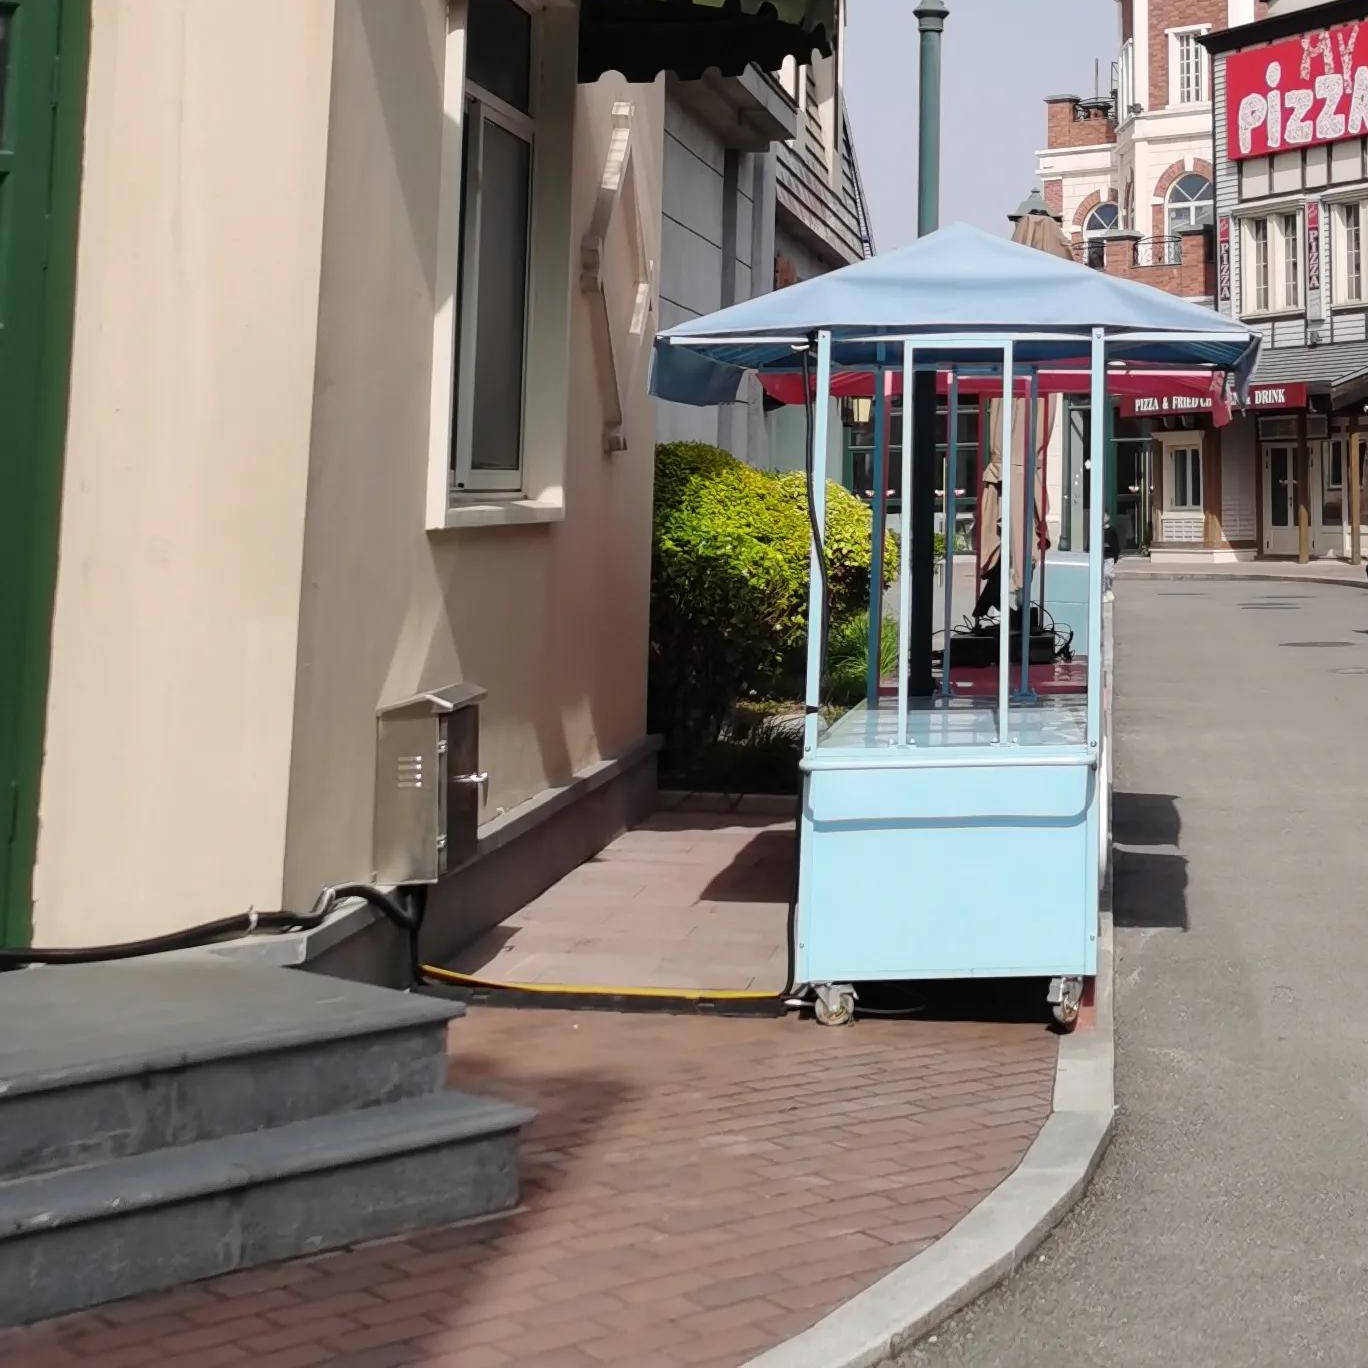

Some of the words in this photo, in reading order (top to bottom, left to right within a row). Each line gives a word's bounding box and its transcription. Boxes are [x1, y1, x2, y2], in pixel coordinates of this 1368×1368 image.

[1220, 243, 1230, 299] PIZZA
[1309, 230, 1319, 288] PIZZA
[1135, 398, 1159, 411] PIZZA
[1162, 397, 1169, 409] &
[1254, 389, 1285, 404] DRINK
